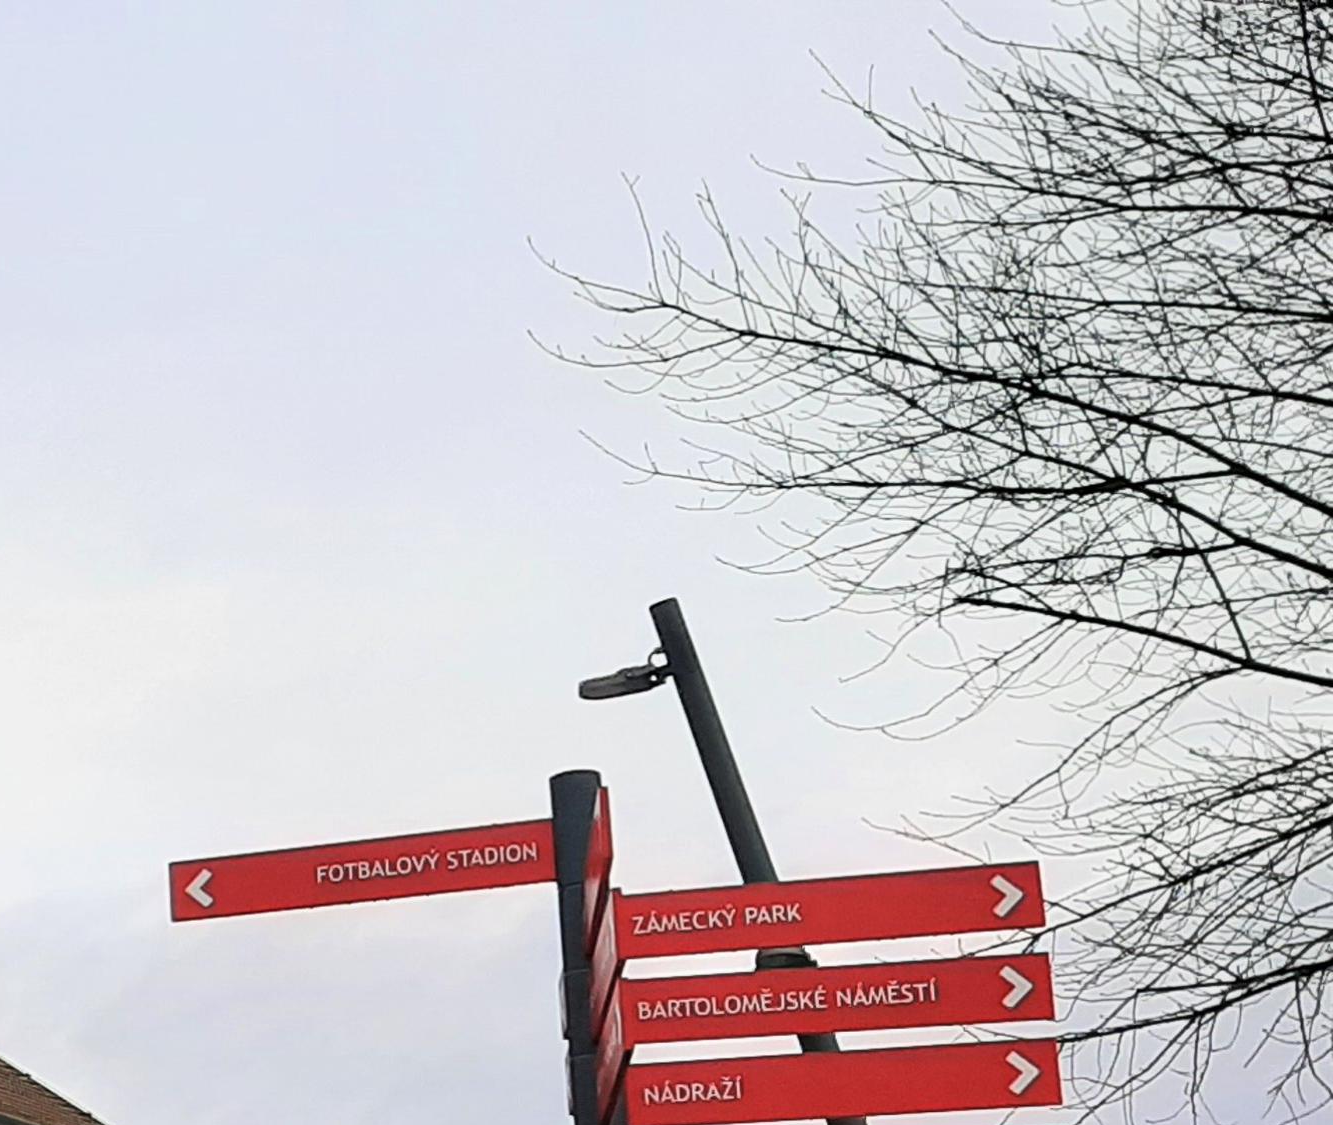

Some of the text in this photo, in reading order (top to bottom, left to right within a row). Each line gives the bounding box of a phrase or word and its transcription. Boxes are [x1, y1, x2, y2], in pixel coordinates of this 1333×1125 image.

[316, 842, 537, 884] FOTBALOVÝ STADION
[631, 902, 802, 934] ZÁMECKÝ PARK
[637, 976, 937, 1021] BARTOLOMĚJSKÉ NÁMĚSTÍ
[643, 1075, 743, 1106] NÁDRAŽÍ
